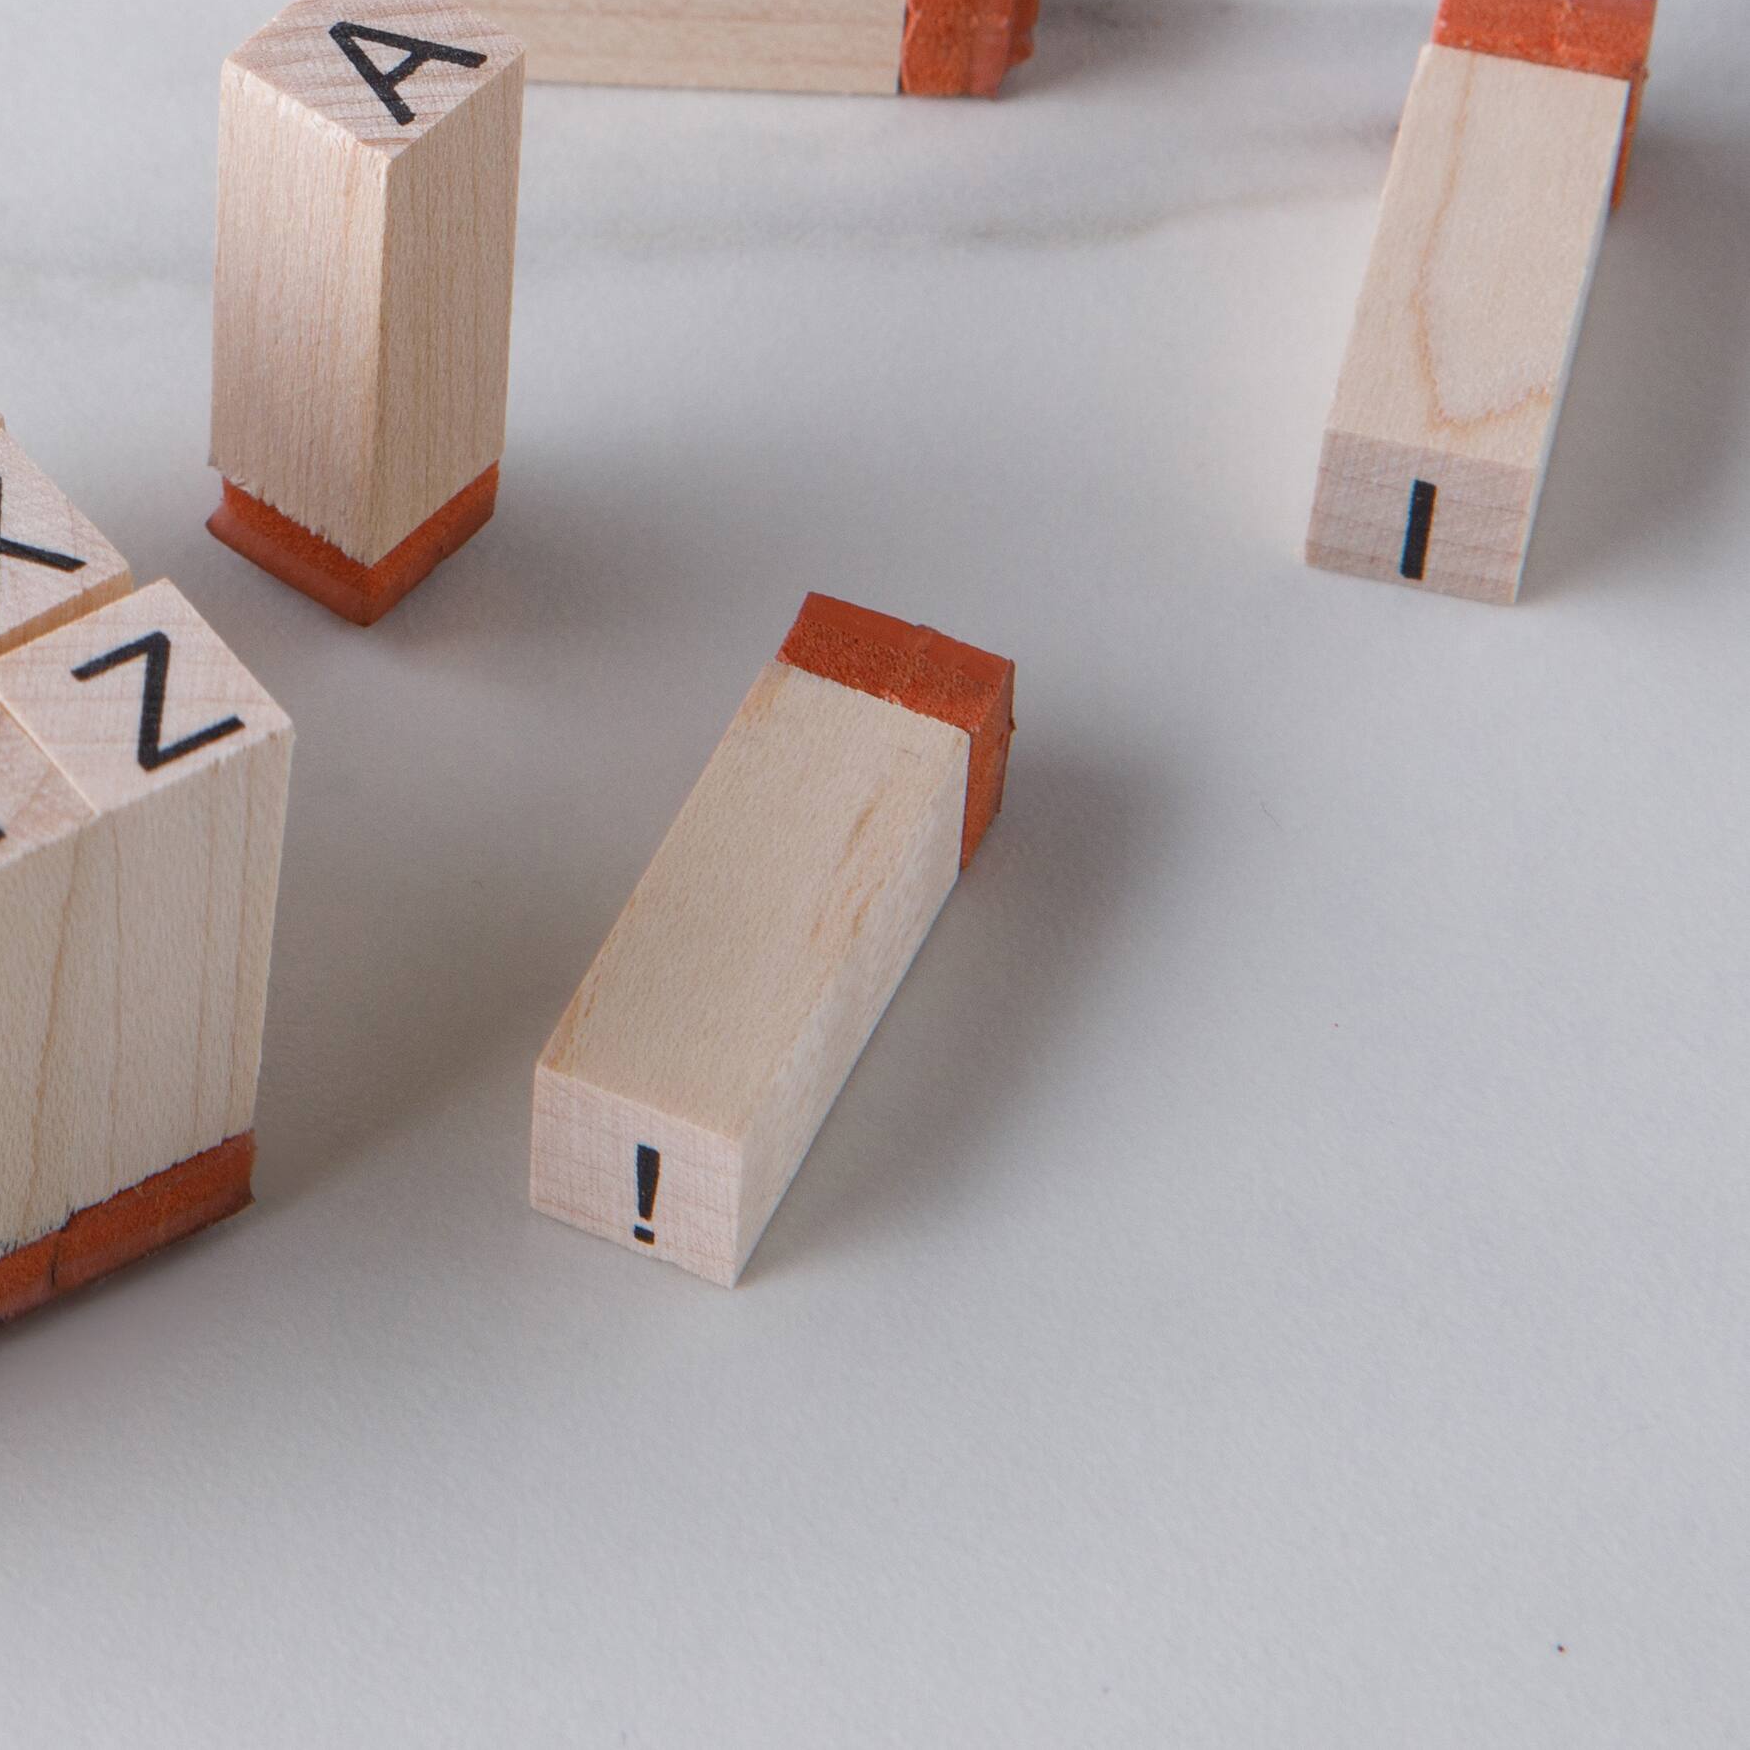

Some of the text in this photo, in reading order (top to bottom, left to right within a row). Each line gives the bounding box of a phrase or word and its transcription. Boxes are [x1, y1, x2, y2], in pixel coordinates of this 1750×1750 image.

[329, 22, 487, 126] A
[1400, 480, 1436, 580] I
[72, 632, 244, 771] Z
[634, 1145, 660, 1244] !
